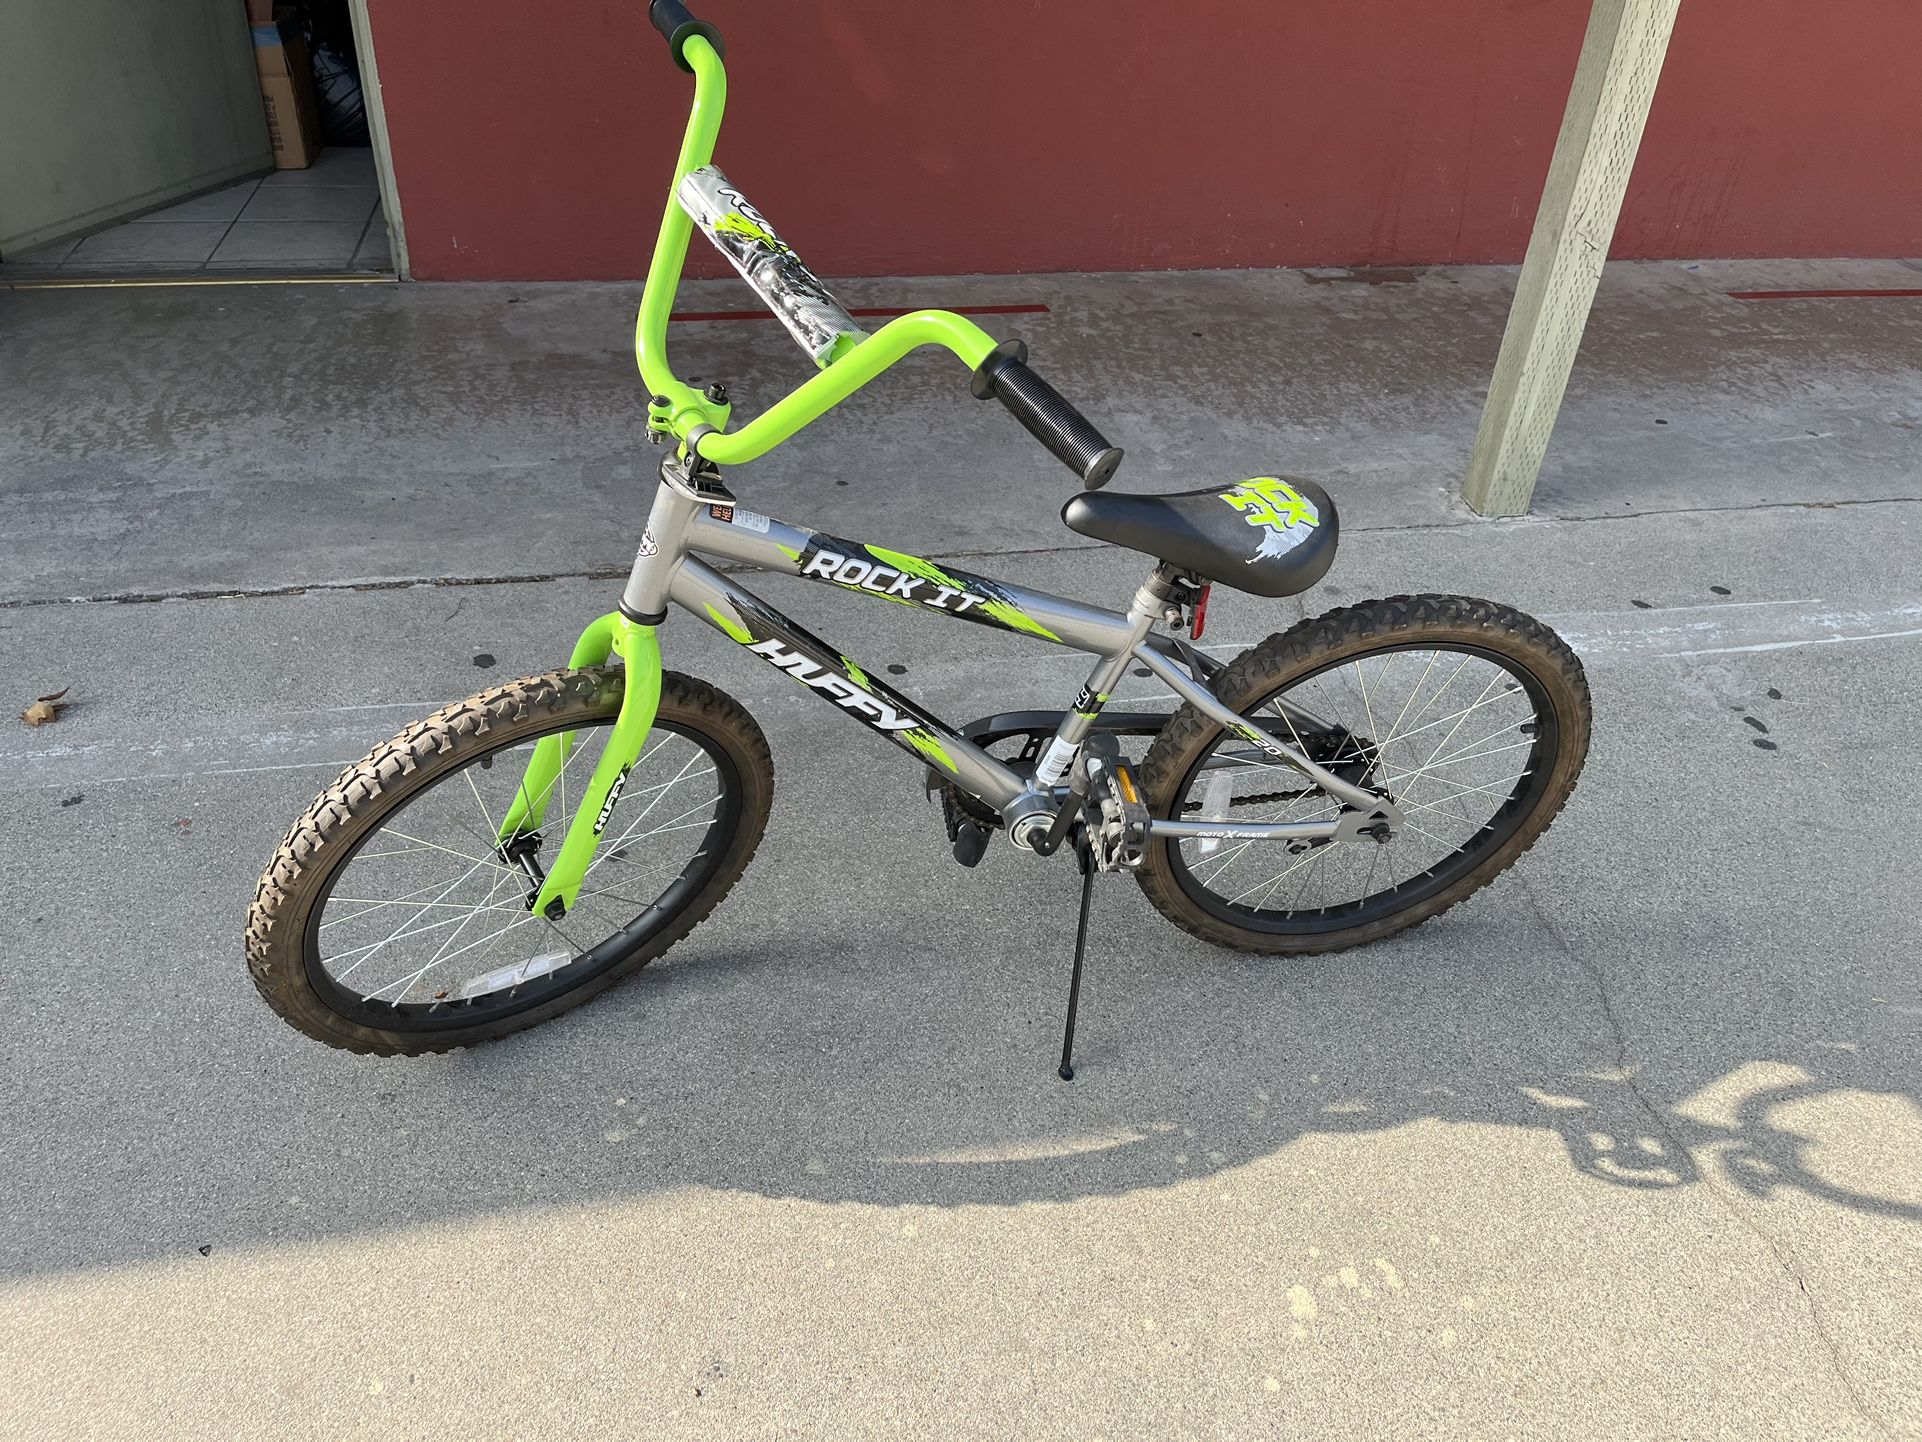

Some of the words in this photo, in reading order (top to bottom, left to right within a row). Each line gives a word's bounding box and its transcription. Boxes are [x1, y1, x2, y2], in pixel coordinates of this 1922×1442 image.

[803, 549, 925, 599] ROCK
[923, 585, 986, 612] IT
[746, 638, 921, 730] HUFFY
[1251, 738, 1281, 755] 20
[594, 771, 626, 831] HUFFY
[1223, 830, 1238, 839] X
